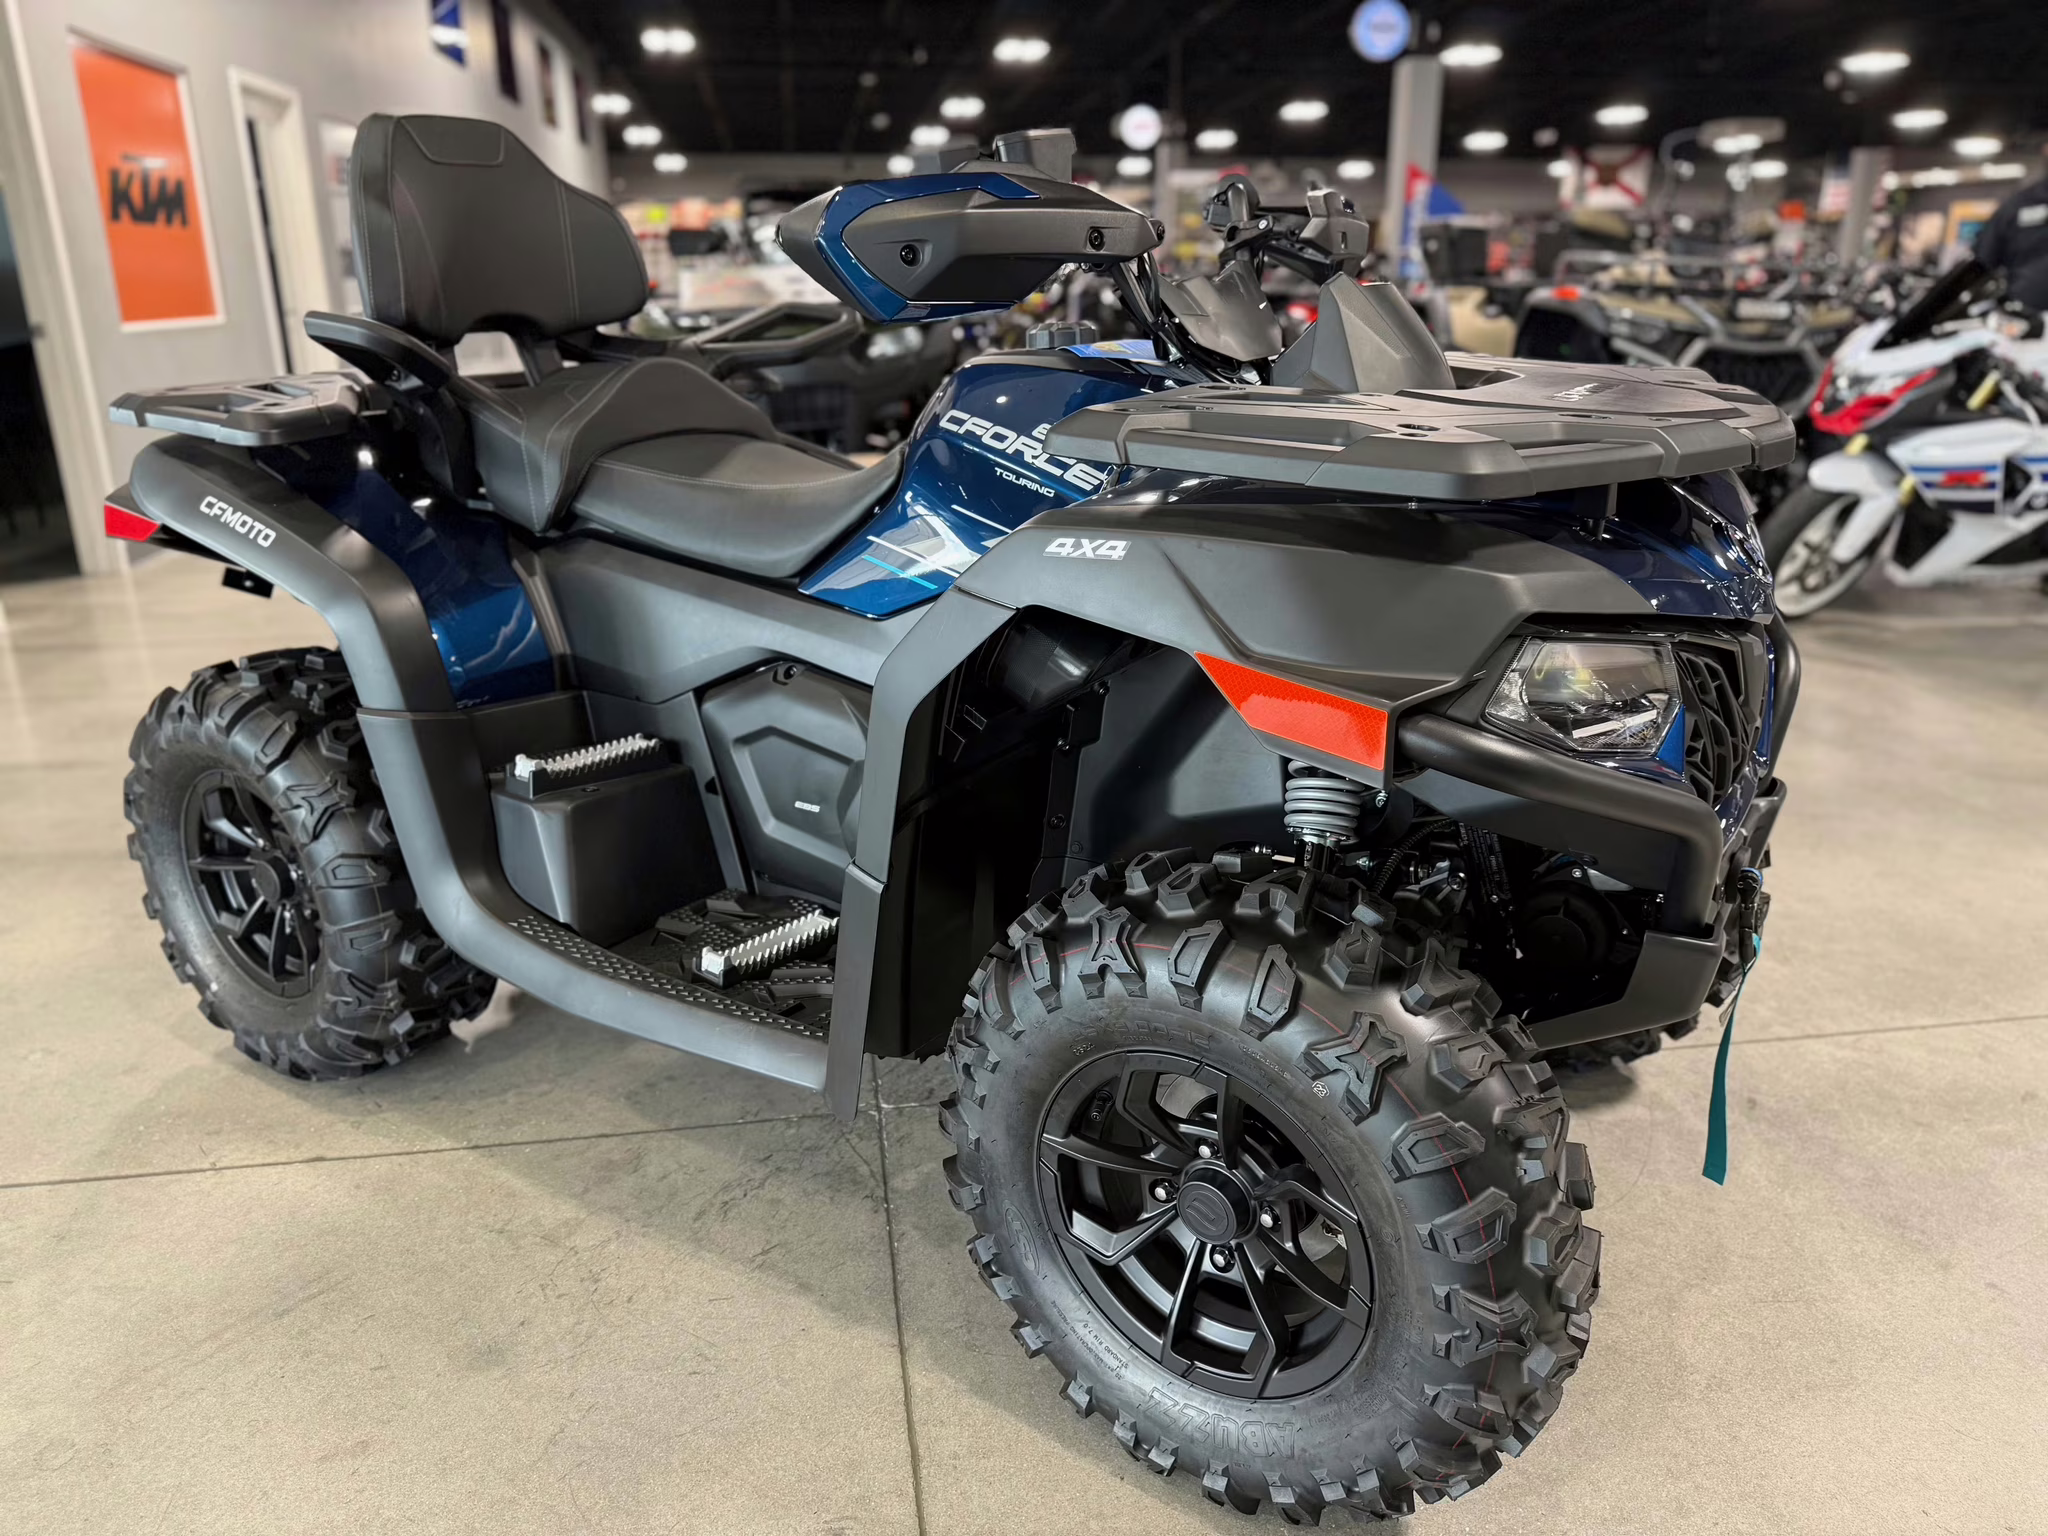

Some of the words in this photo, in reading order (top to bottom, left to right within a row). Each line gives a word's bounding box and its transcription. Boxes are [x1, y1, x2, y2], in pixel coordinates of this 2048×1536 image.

[109, 151, 189, 229] KTM
[939, 409, 1108, 491] CFORCE
[994, 467, 1055, 498] TOURING
[199, 495, 277, 548] CFMOTO
[1044, 537, 1128, 559] 4X4
[1083, 1323, 1093, 1334] 7.0
[1093, 1334, 1104, 1346] RIM
[1104, 1345, 1129, 1369] STANDARD
[1144, 1386, 1296, 1459] ABUZZ
